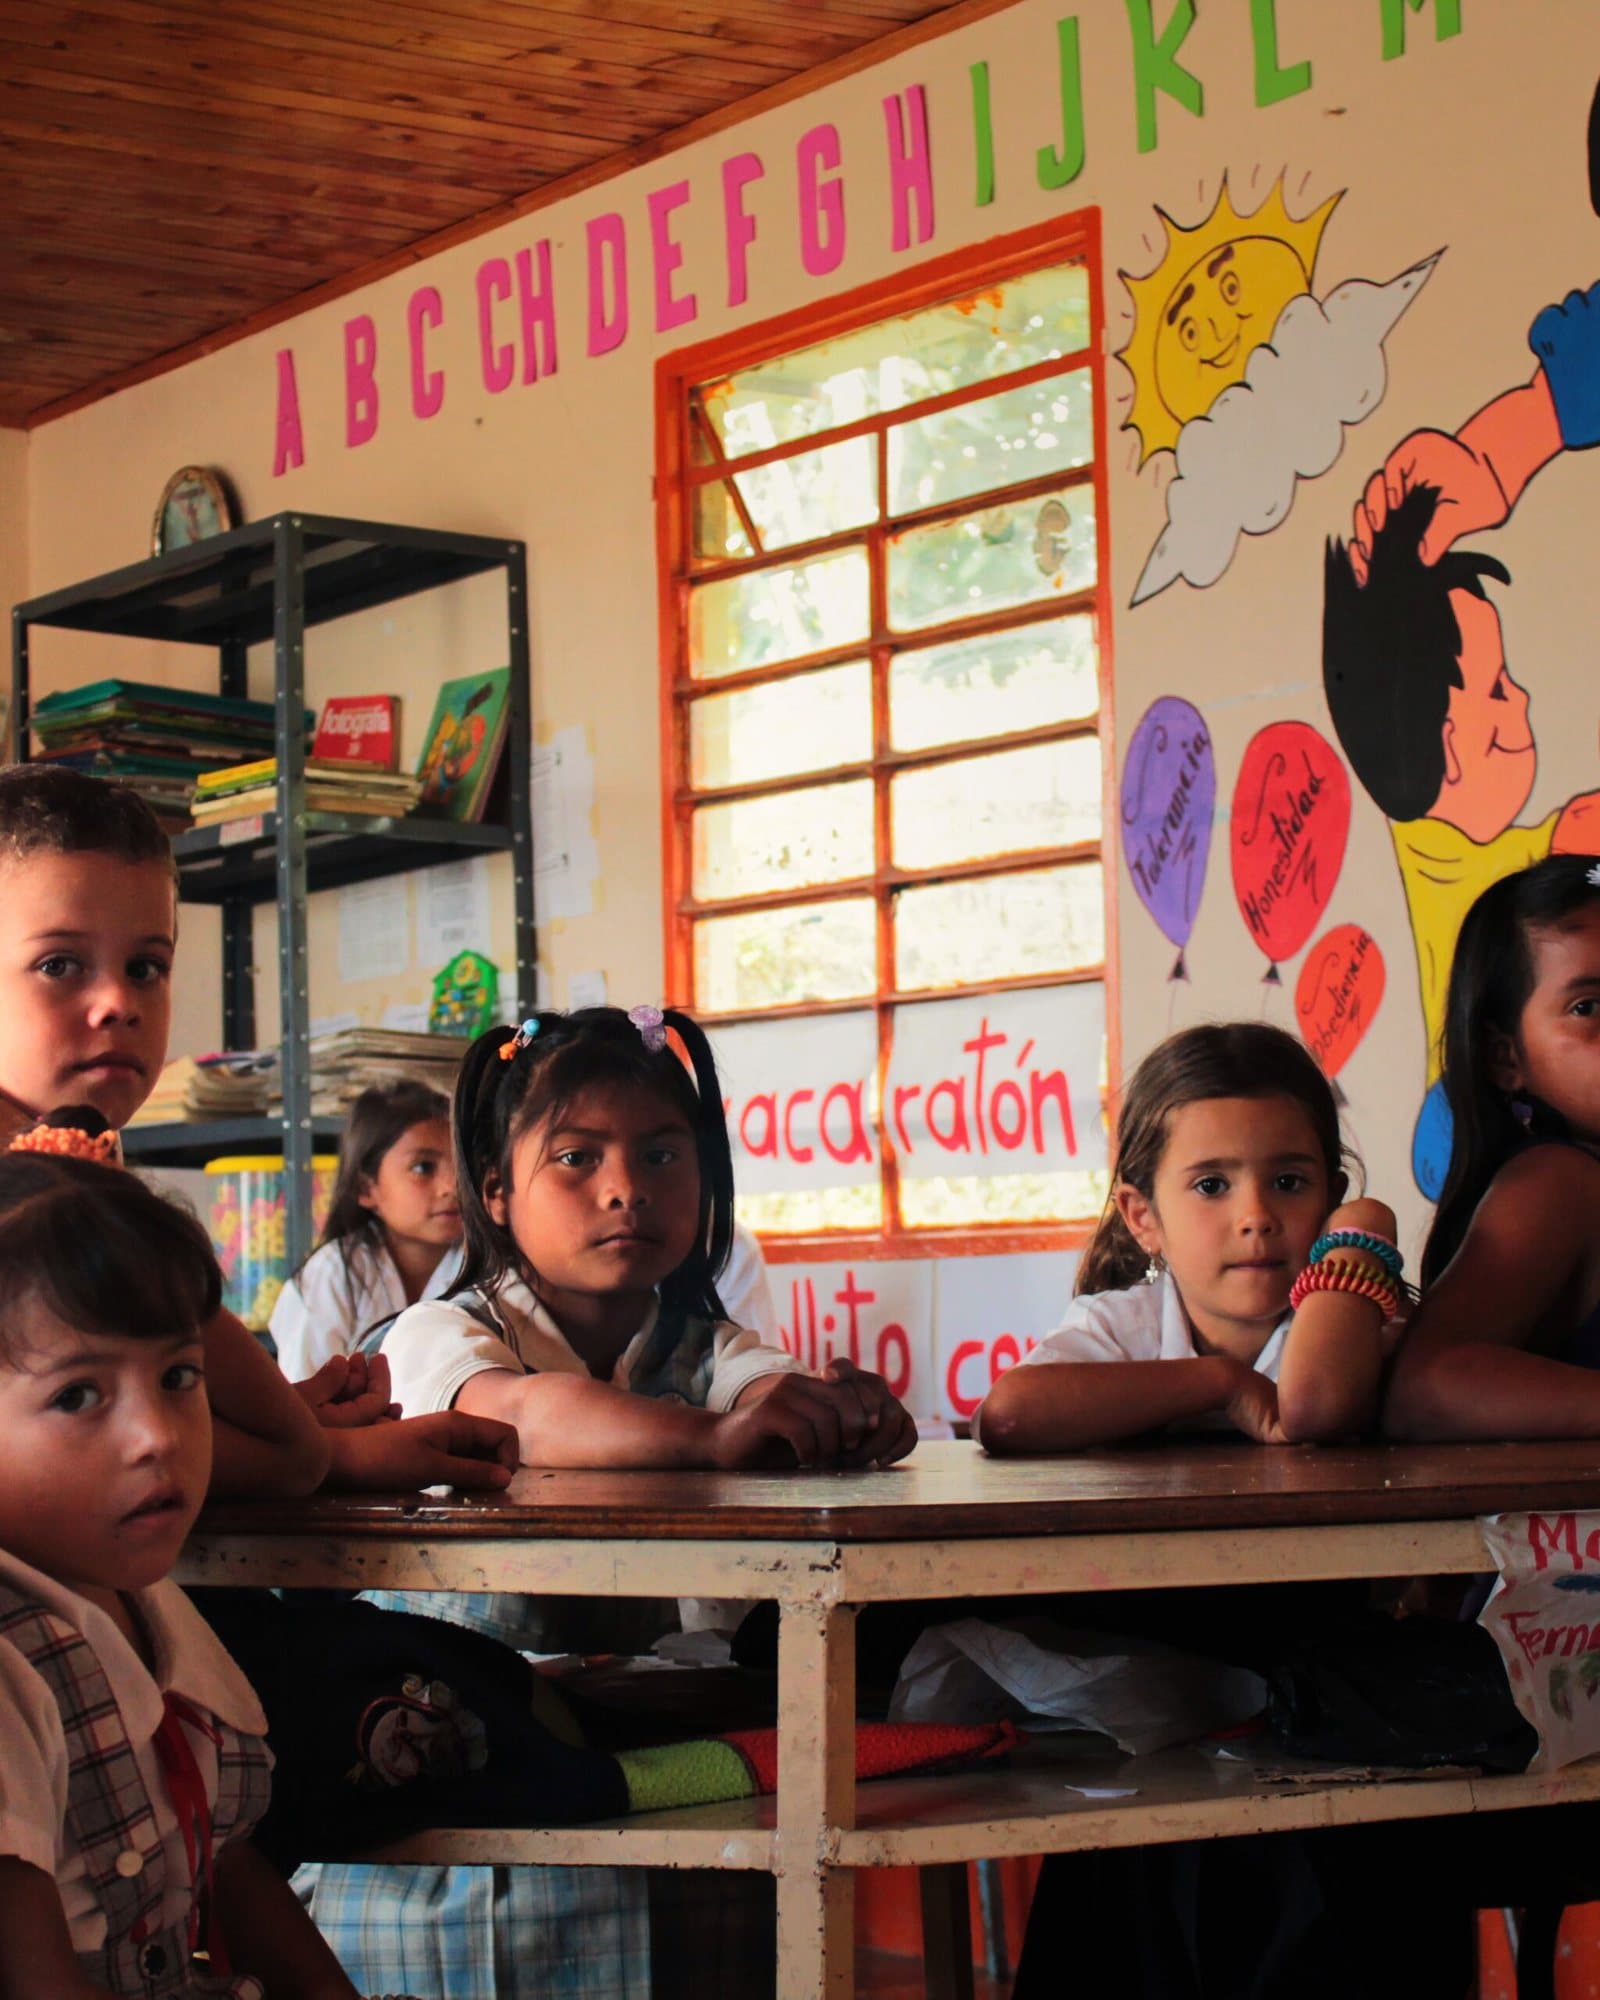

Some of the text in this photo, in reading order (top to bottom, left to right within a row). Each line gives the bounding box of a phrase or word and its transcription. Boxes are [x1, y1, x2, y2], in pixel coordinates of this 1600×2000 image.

[273, 348, 304, 477] A
[344, 314, 379, 448] B
[407, 285, 445, 420] C
[586, 212, 630, 358] D
[646, 179, 698, 333] E
[721, 152, 765, 308] F
[796, 122, 846, 277] G
[882, 83, 935, 253] H
[971, 62, 996, 207] I
[1036, 15, 1086, 190] J
[1126, 0, 1203, 153] K
[1242, 749, 1327, 938] Honestidad
[722, 1016, 1078, 1165] aca ratón
[779, 1268, 1037, 1419] llito ce
